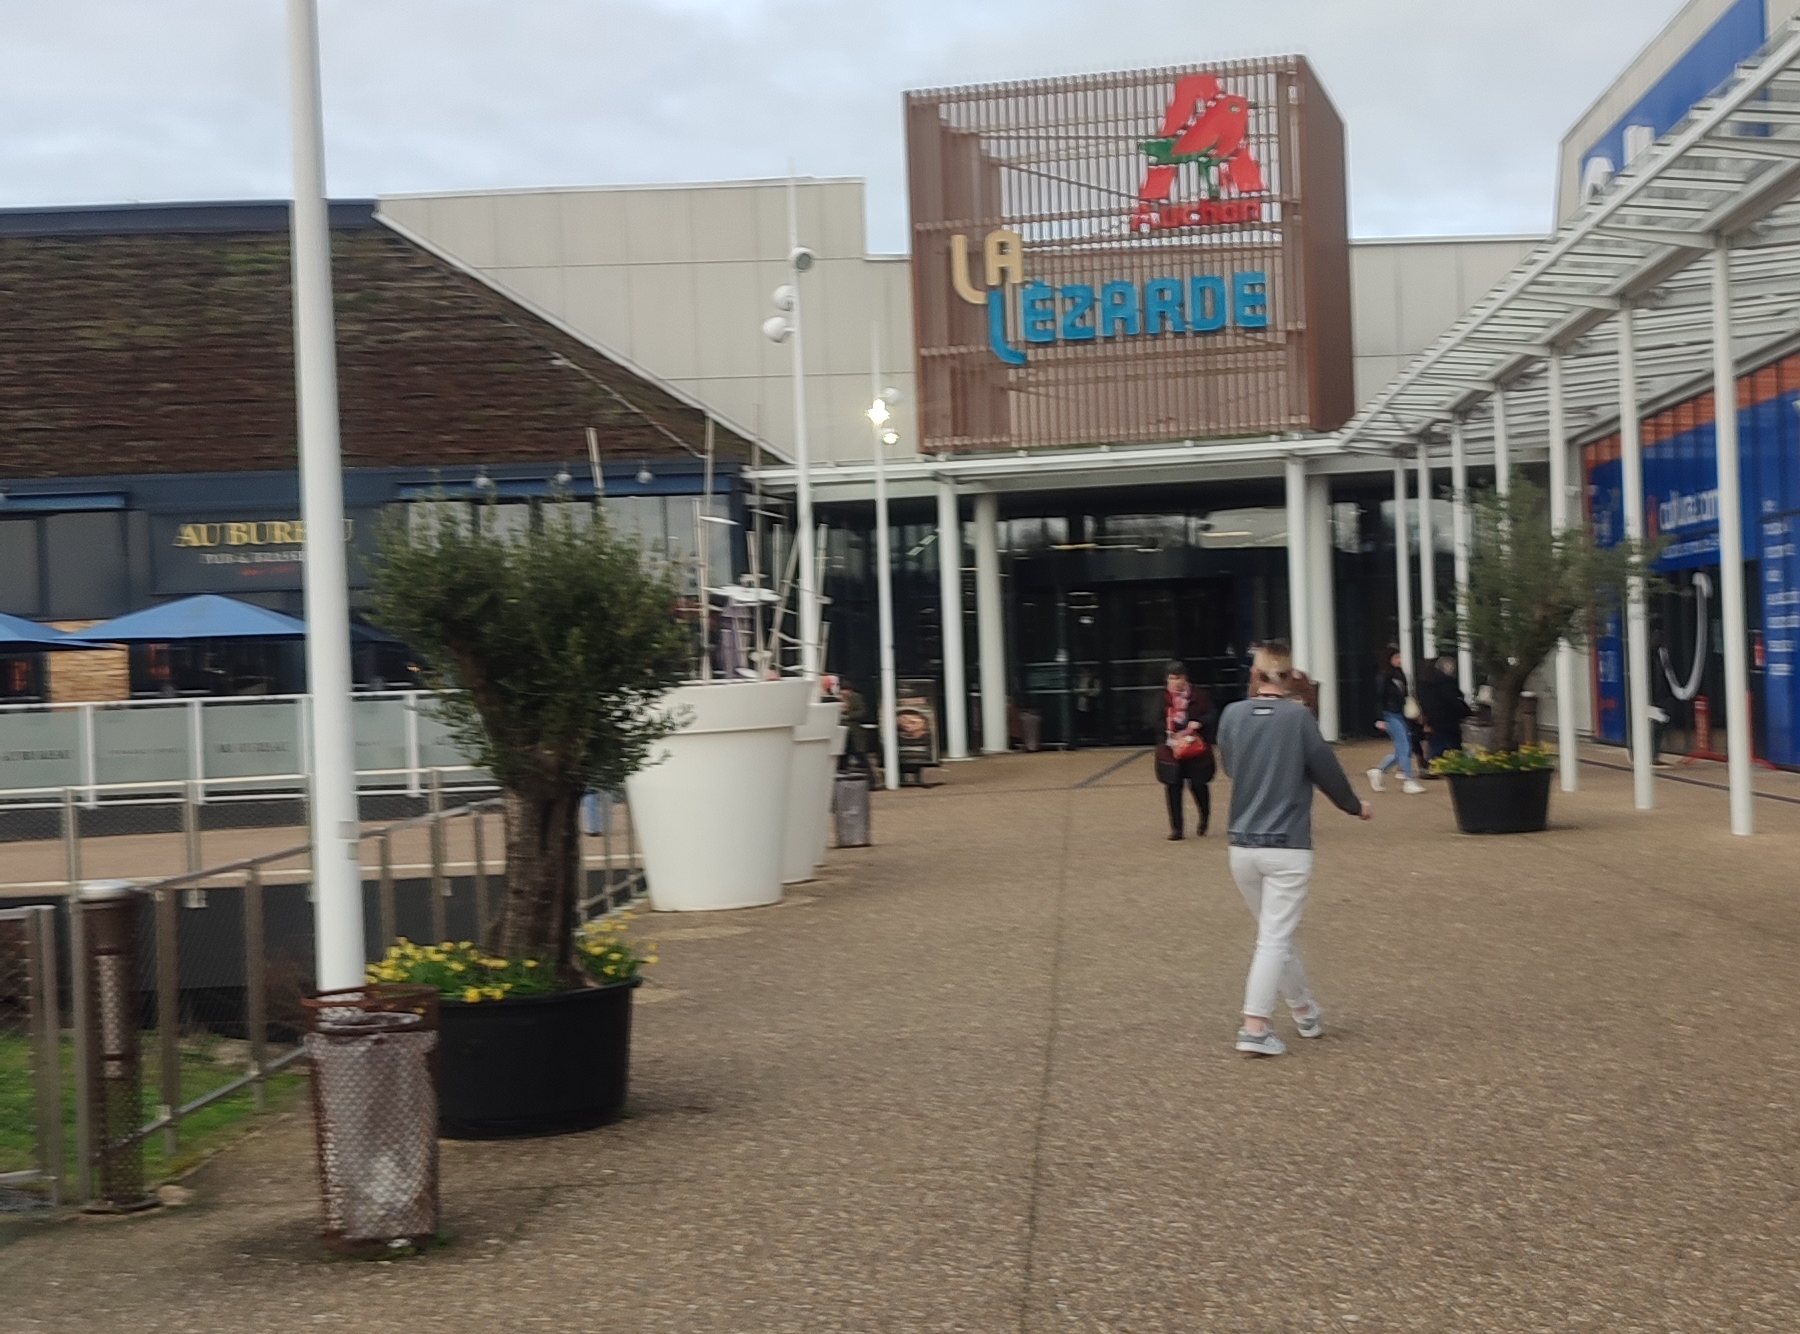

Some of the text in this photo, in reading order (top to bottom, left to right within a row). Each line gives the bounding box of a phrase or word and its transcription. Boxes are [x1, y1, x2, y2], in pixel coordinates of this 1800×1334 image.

[1131, 199, 1261, 231] Auchan
[952, 230, 1023, 305] LA
[988, 271, 1268, 366] LÉZARDE
[172, 519, 354, 546] AU BUREU
